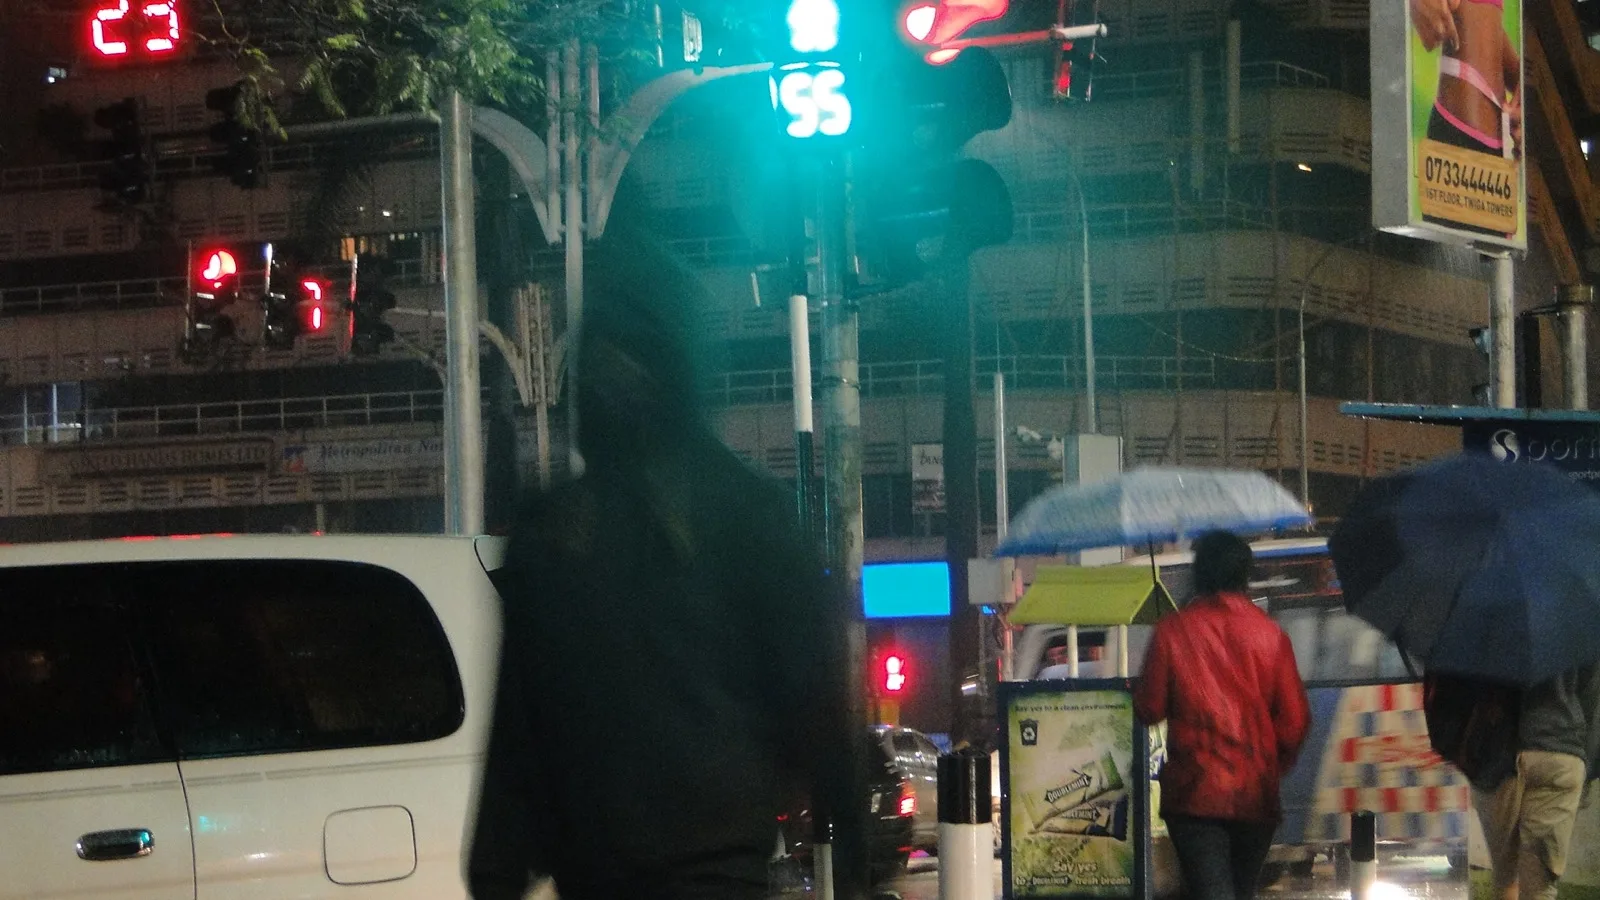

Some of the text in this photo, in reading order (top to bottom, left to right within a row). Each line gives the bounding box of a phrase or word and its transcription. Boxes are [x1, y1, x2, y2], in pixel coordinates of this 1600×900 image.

[779, 68, 852, 138] 55
[1425, 156, 1511, 200] 0733444446
[1464, 196, 1485, 211] TWIGA
[1487, 201, 1513, 218] TOWERS
[1047, 776, 1089, 802] DOUBLEMINT
[1052, 861, 1098, 876] Say yes
